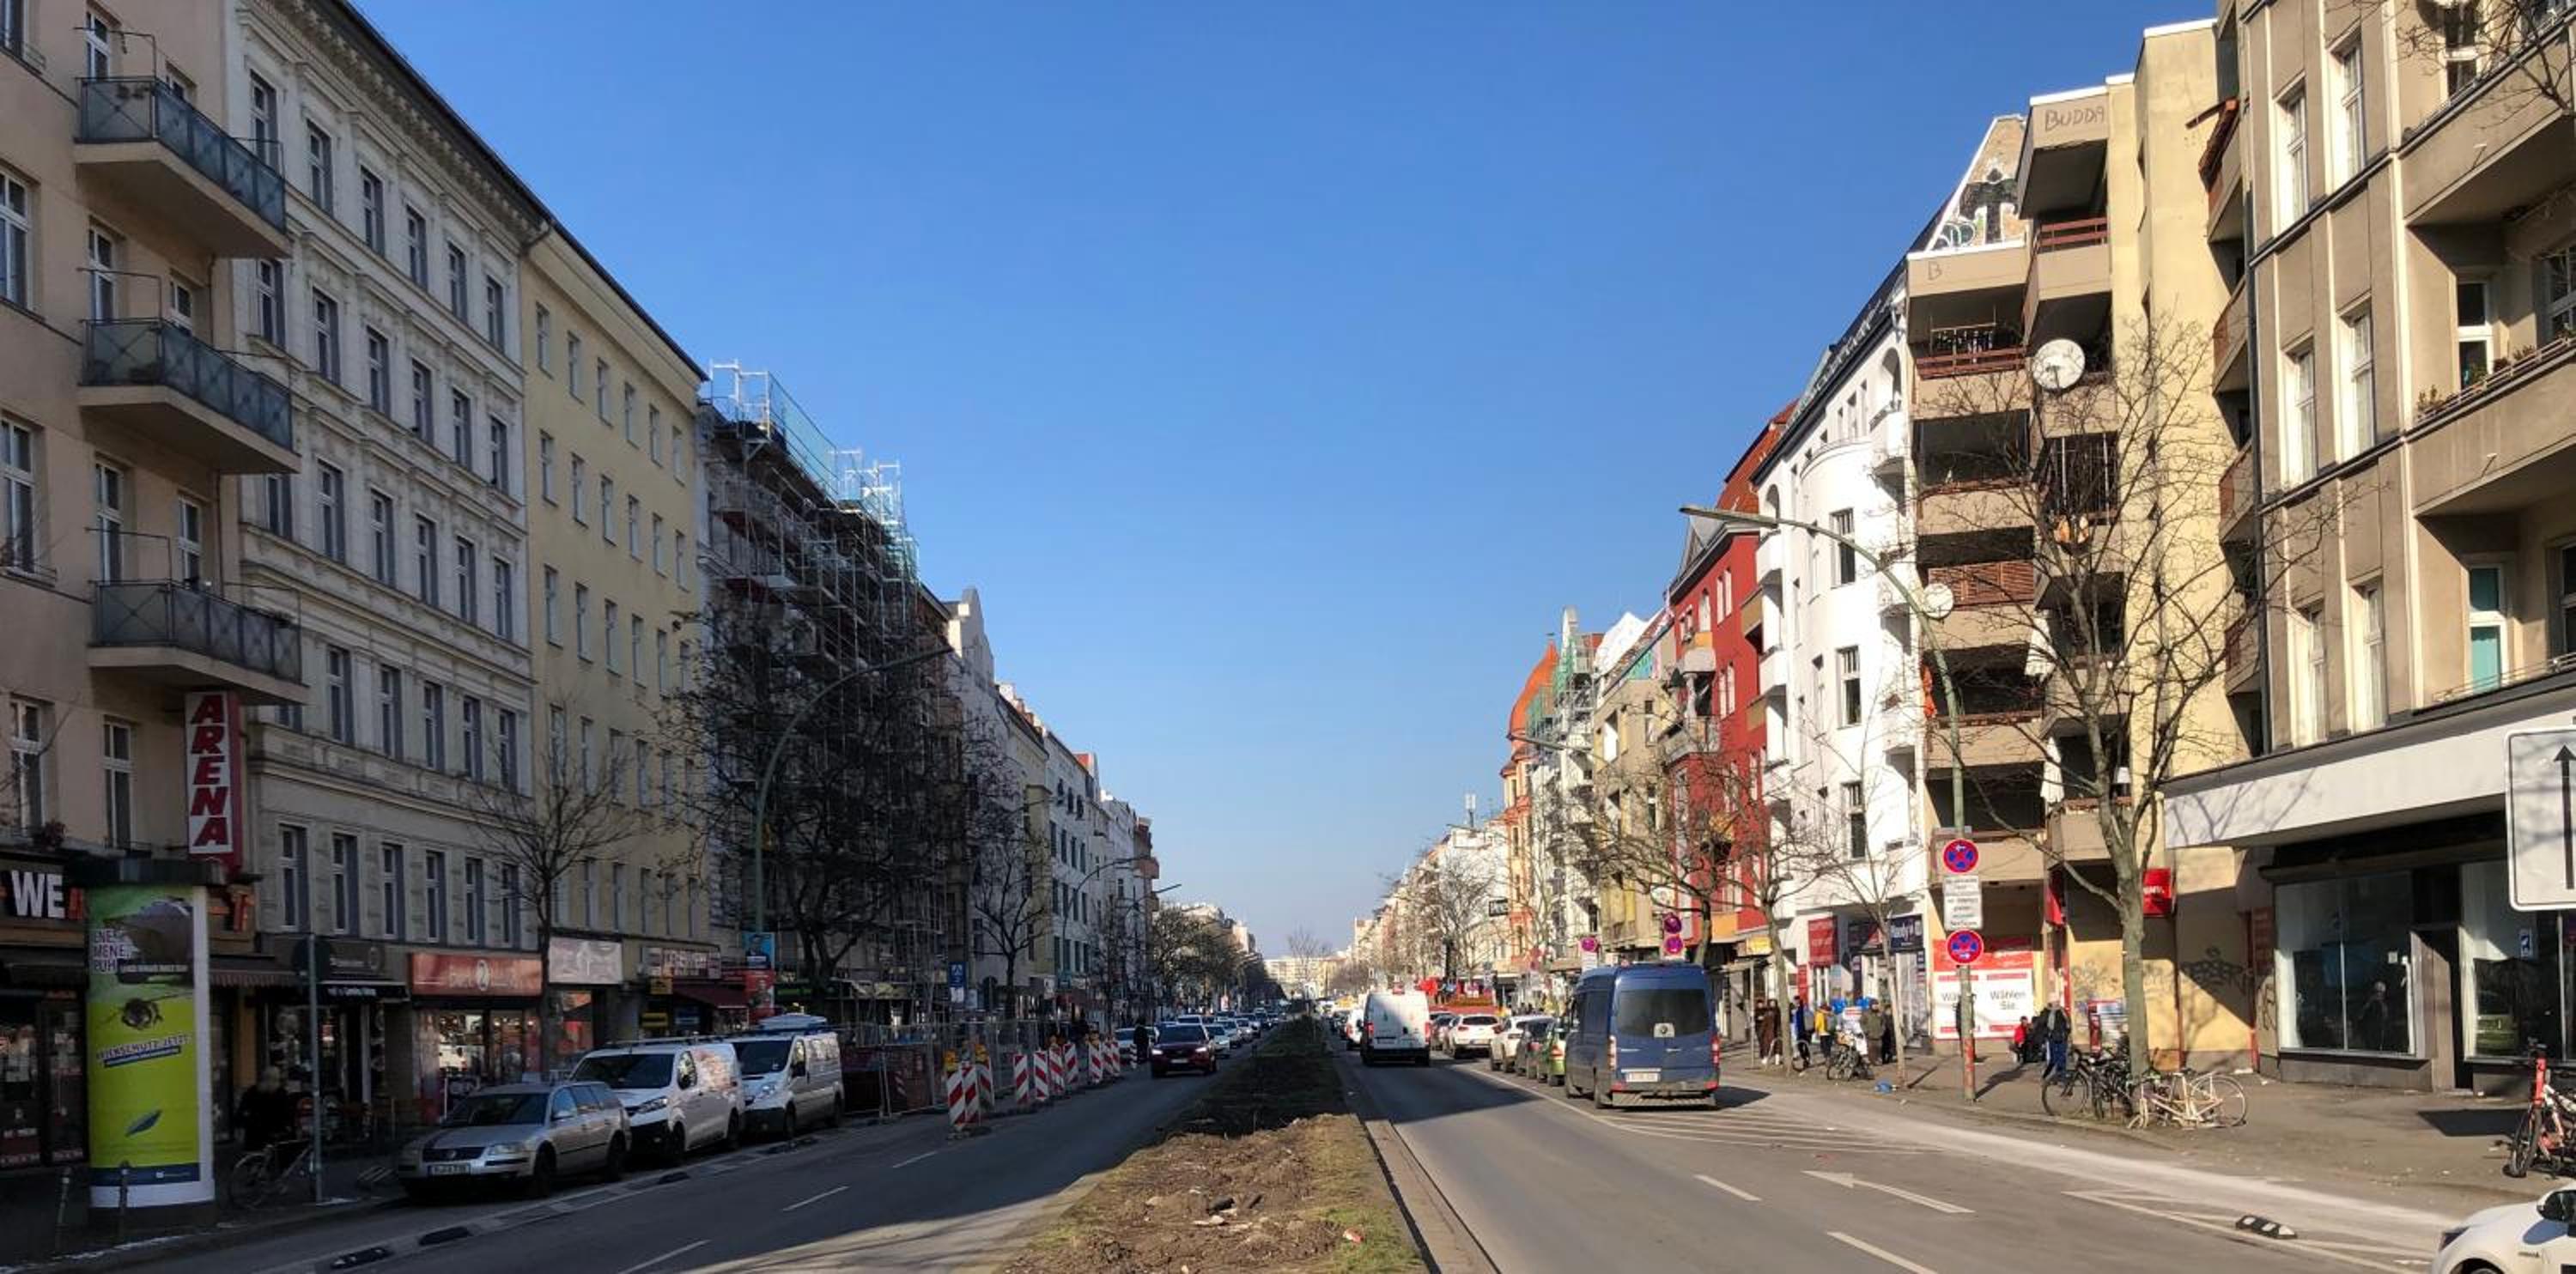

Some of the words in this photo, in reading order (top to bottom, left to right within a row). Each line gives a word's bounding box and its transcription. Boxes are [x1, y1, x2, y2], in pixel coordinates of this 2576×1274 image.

[2044, 106, 2105, 132] BUDDA
[190, 695, 228, 846] ARENA
[11, 870, 66, 919] WE
[1990, 990, 2026, 1000] Wählen
[2000, 1001, 2015, 1010] Sie
